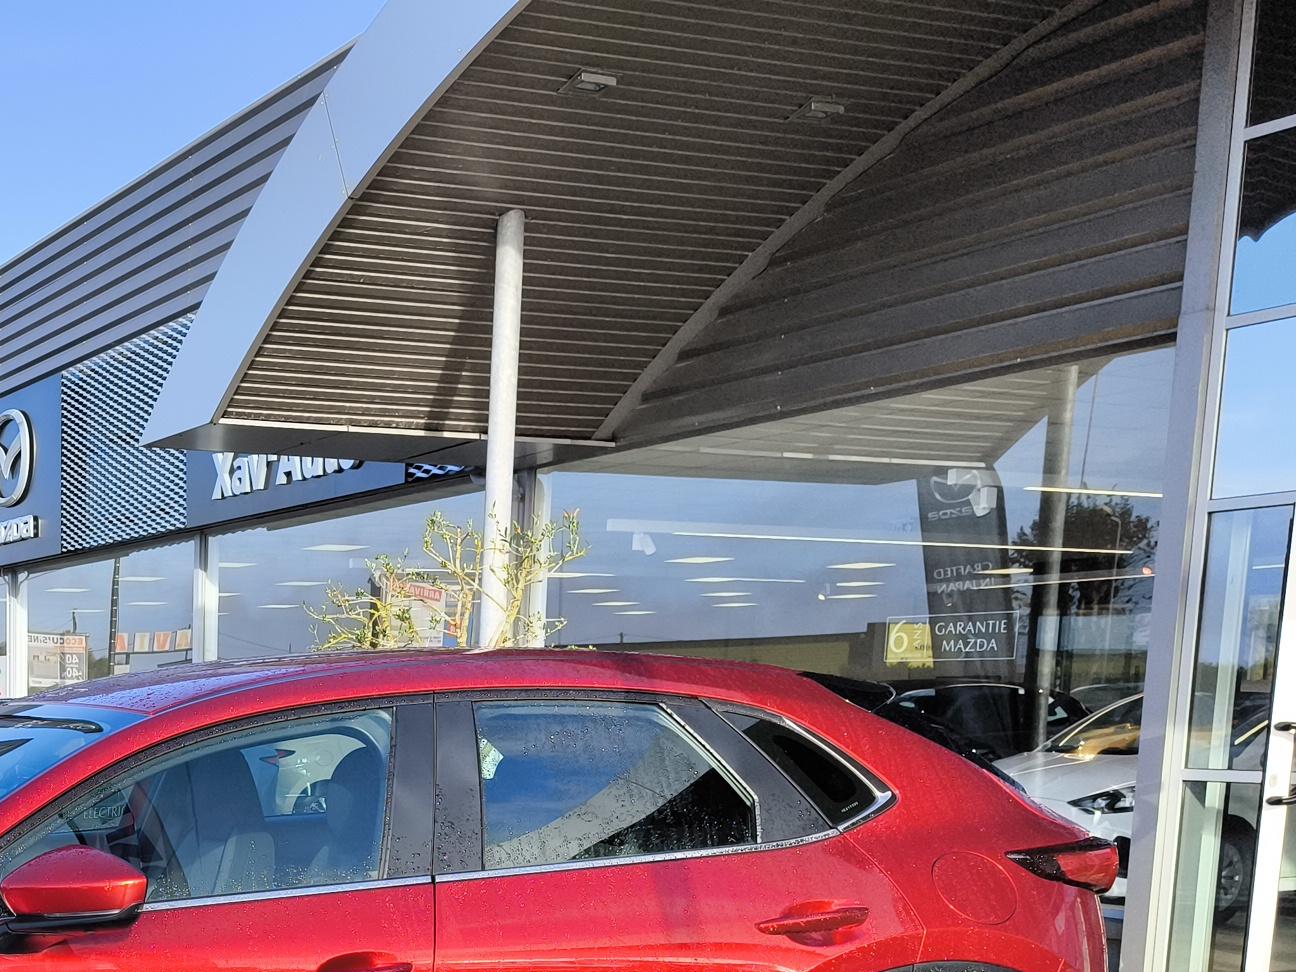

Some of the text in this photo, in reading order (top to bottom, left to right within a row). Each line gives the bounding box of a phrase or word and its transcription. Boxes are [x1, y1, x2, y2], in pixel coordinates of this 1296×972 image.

[889, 619, 909, 653] 6
[935, 619, 1008, 636] GARANTIE
[941, 638, 998, 652] MAZDA
